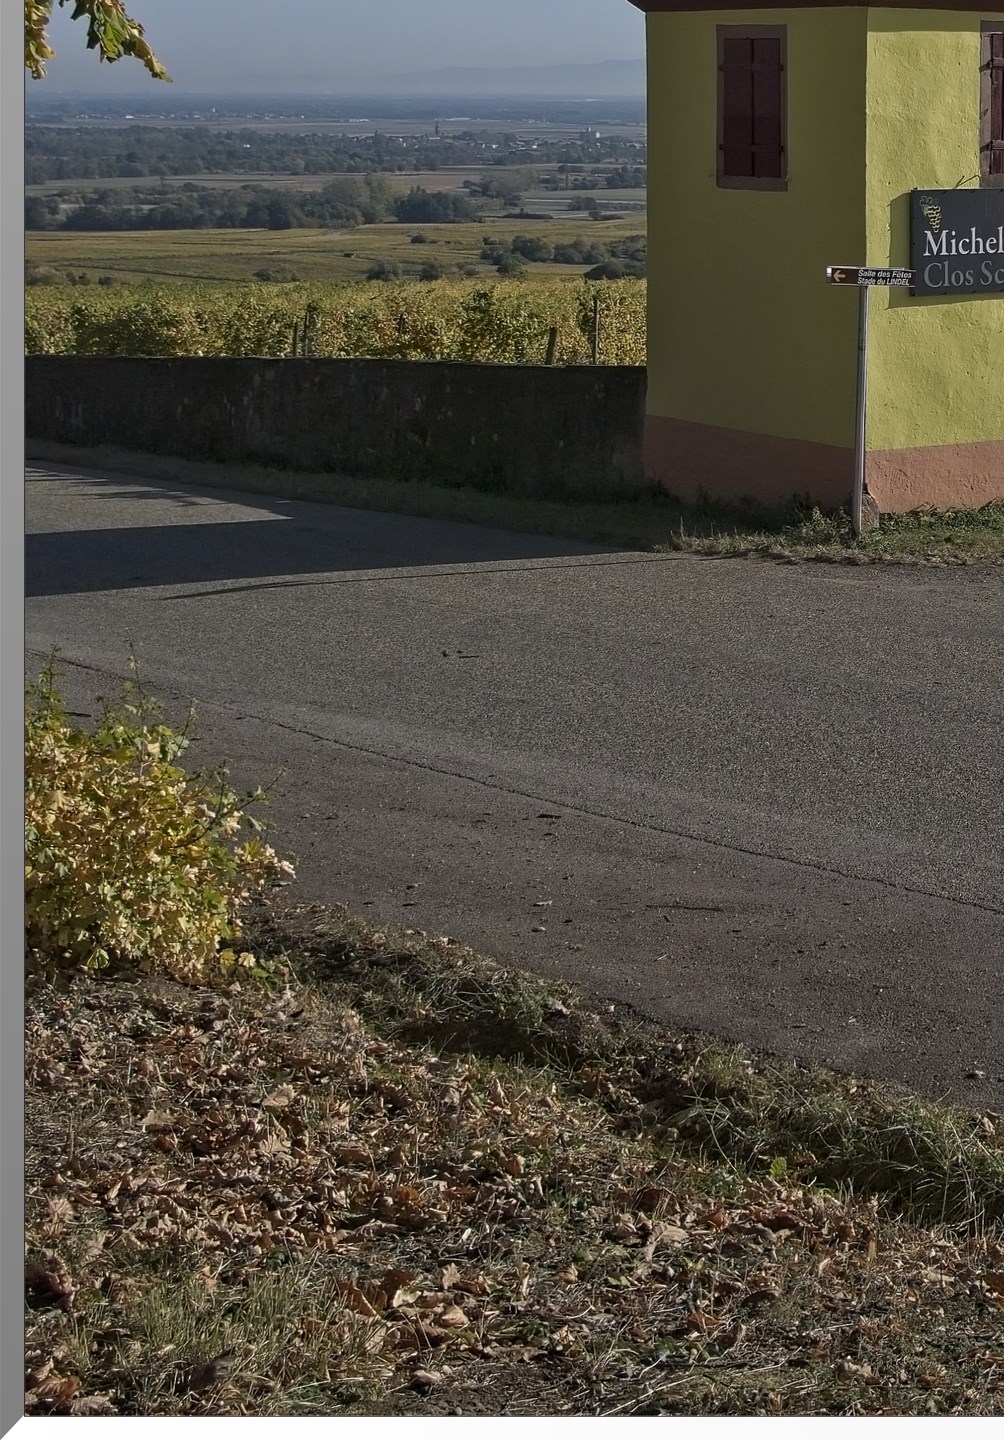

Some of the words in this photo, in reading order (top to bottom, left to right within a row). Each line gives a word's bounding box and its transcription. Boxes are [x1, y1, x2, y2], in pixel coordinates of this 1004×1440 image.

[923, 226, 1004, 257] Michel
[857, 277, 875, 285] Stade
[886, 278, 910, 286] LINDEL
[858, 269, 876, 277] Salle
[877, 270, 891, 278] des
[923, 260, 974, 288] Clos
